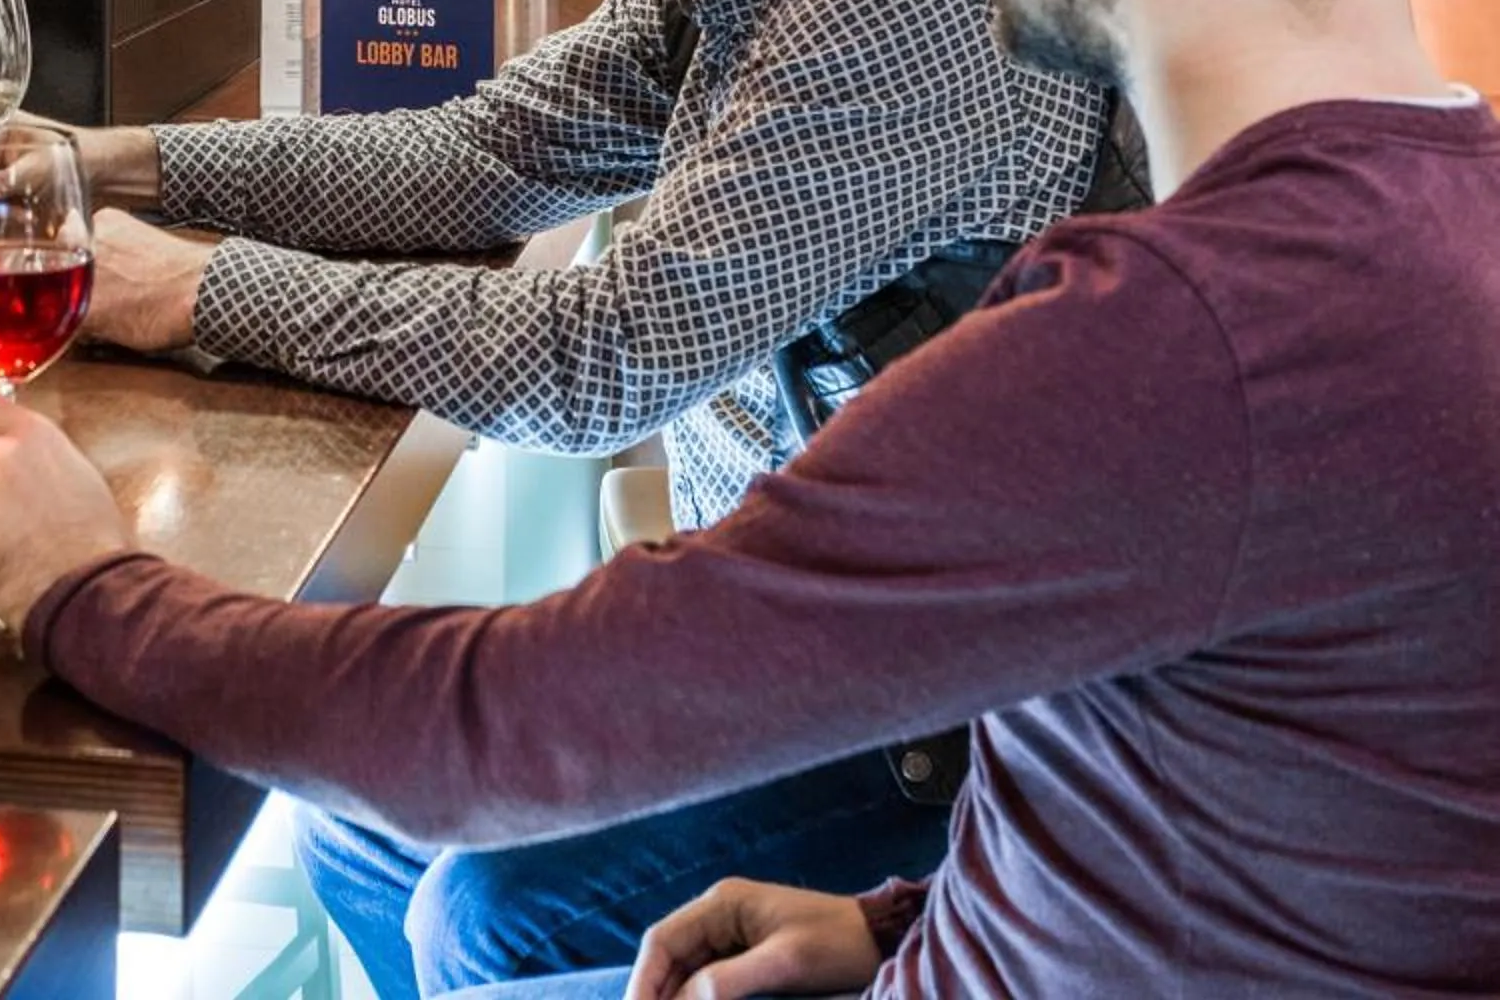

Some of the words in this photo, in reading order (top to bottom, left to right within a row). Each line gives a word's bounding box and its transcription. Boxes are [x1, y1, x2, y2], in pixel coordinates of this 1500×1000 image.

[378, 5, 437, 27] GLOBUS
[356, 40, 416, 67] LOBBY
[421, 42, 459, 70] BAR
